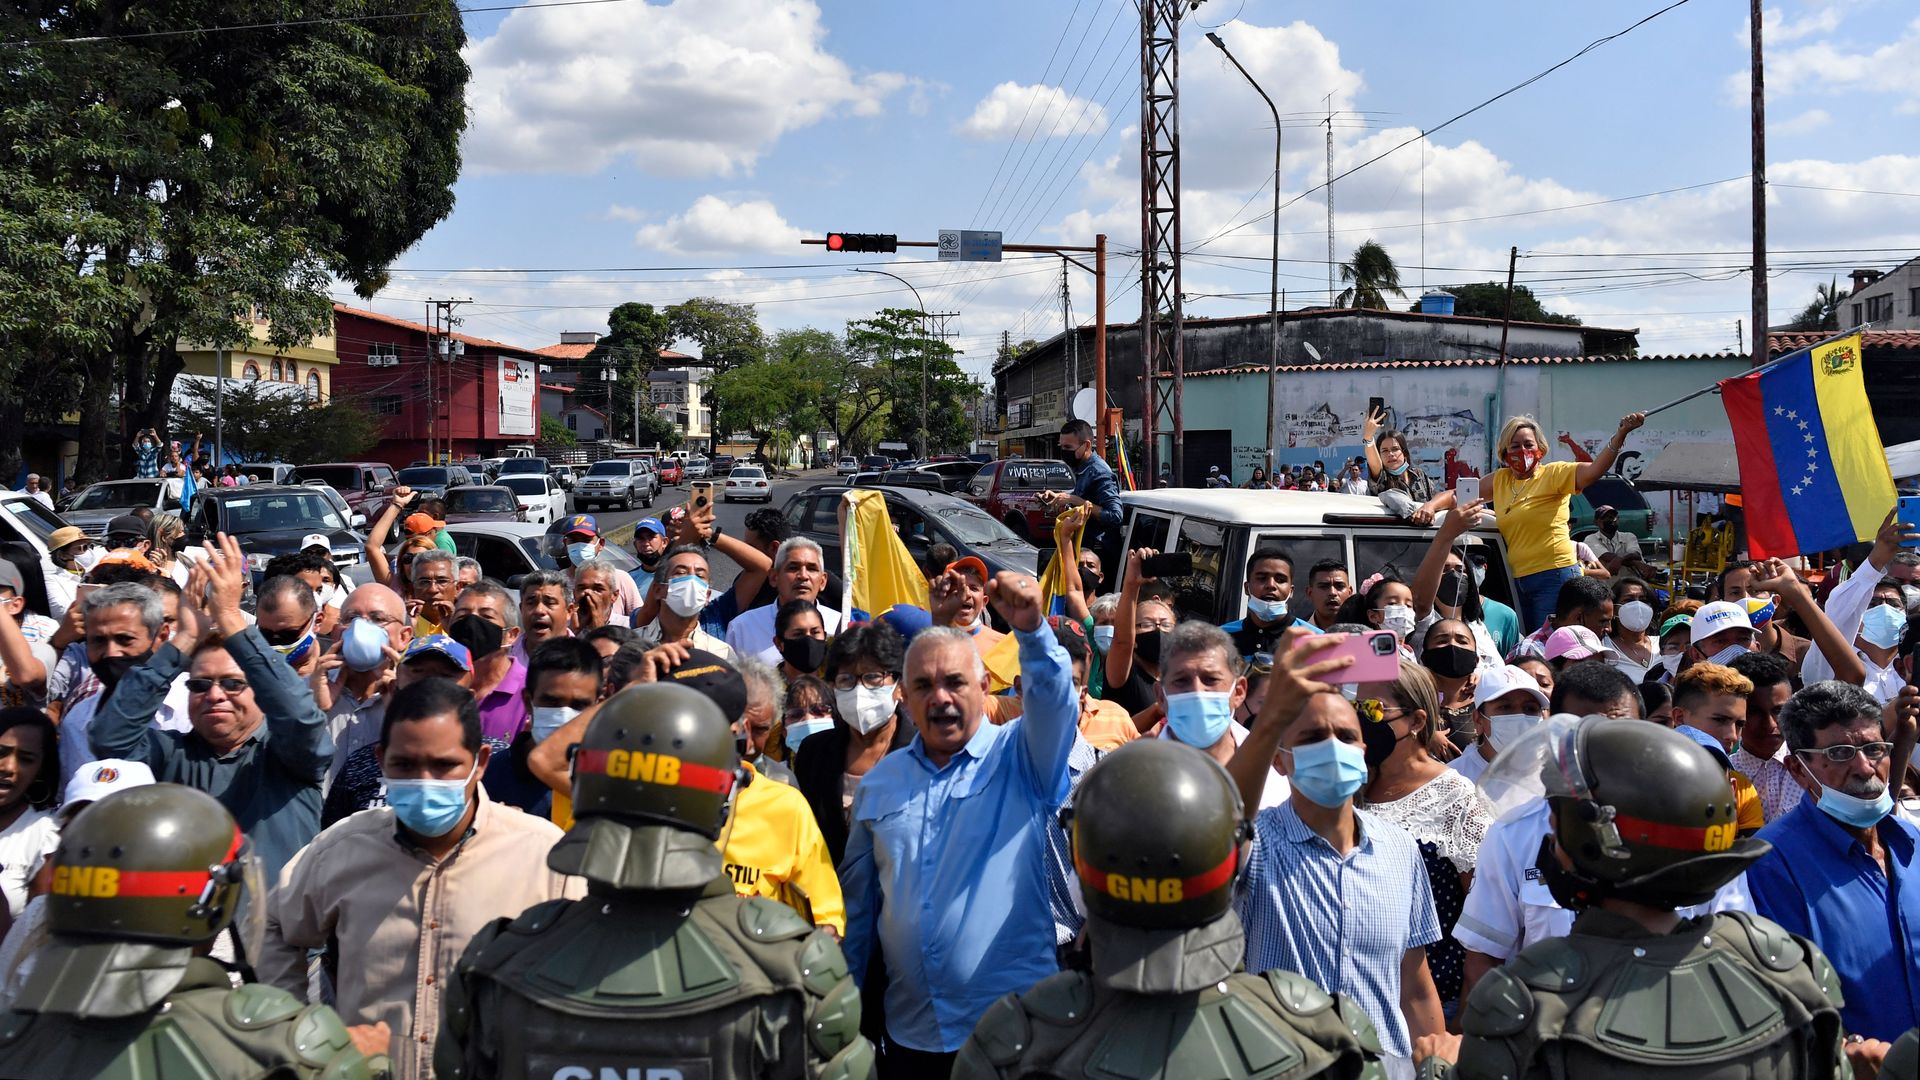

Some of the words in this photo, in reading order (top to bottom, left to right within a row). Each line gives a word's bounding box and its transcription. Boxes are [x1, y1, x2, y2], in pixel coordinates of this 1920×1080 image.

[605, 748, 682, 786] GNB
[1704, 821, 1737, 852] GN
[53, 865, 120, 898] GNB
[1106, 873, 1184, 904] GNB
